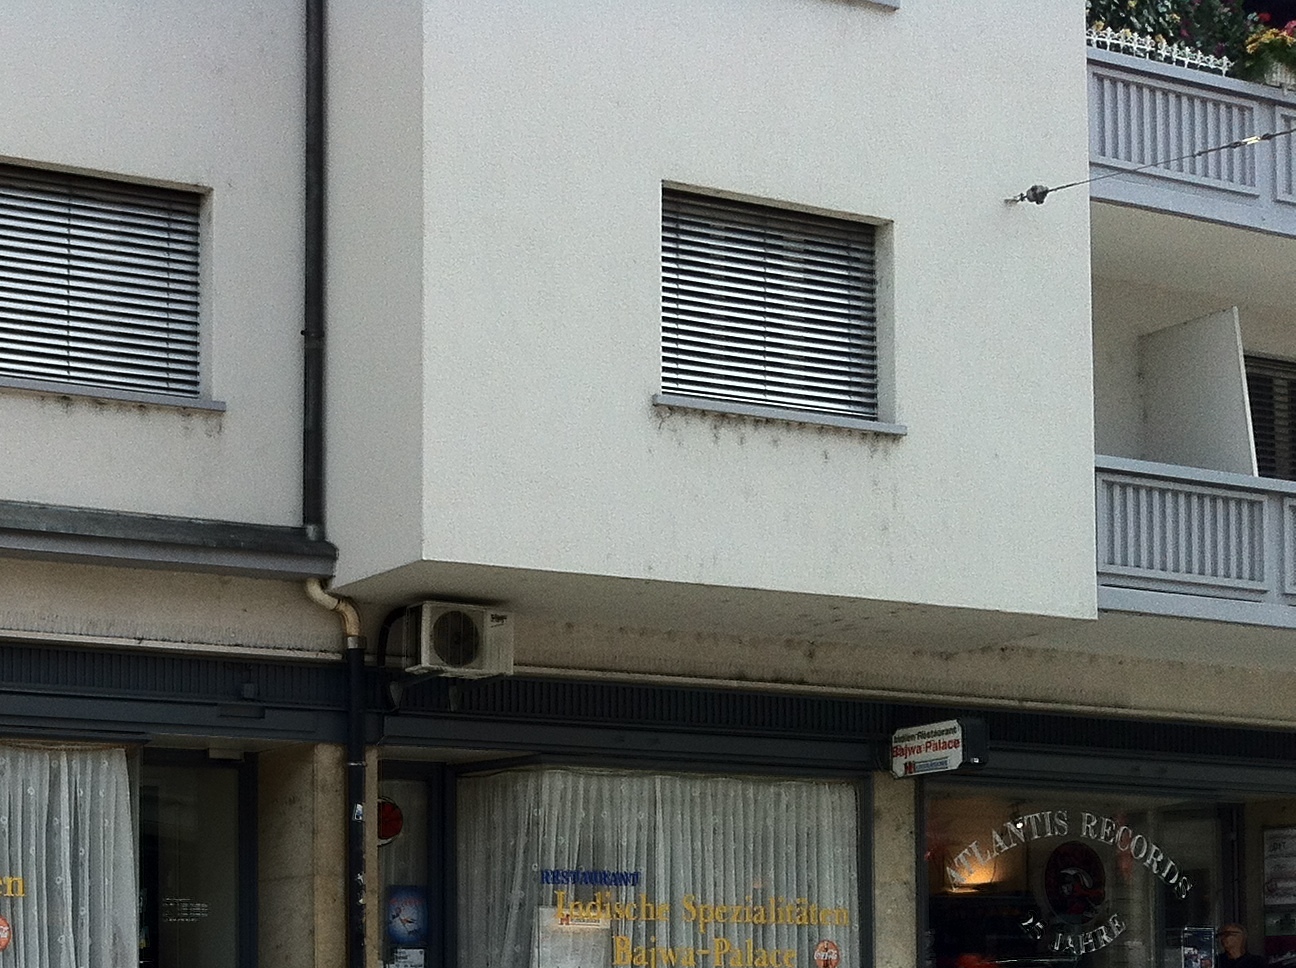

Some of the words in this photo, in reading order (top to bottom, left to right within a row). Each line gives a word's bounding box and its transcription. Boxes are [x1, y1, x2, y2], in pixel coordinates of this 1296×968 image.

[945, 810, 1068, 892] ATLANTIS
[1080, 812, 1193, 899] RECORDS
[541, 869, 642, 887] RESTAURANT
[554, 890, 670, 922] Indische
[682, 894, 851, 934] Spezialitäten
[1048, 913, 1126, 956] JAHRE
